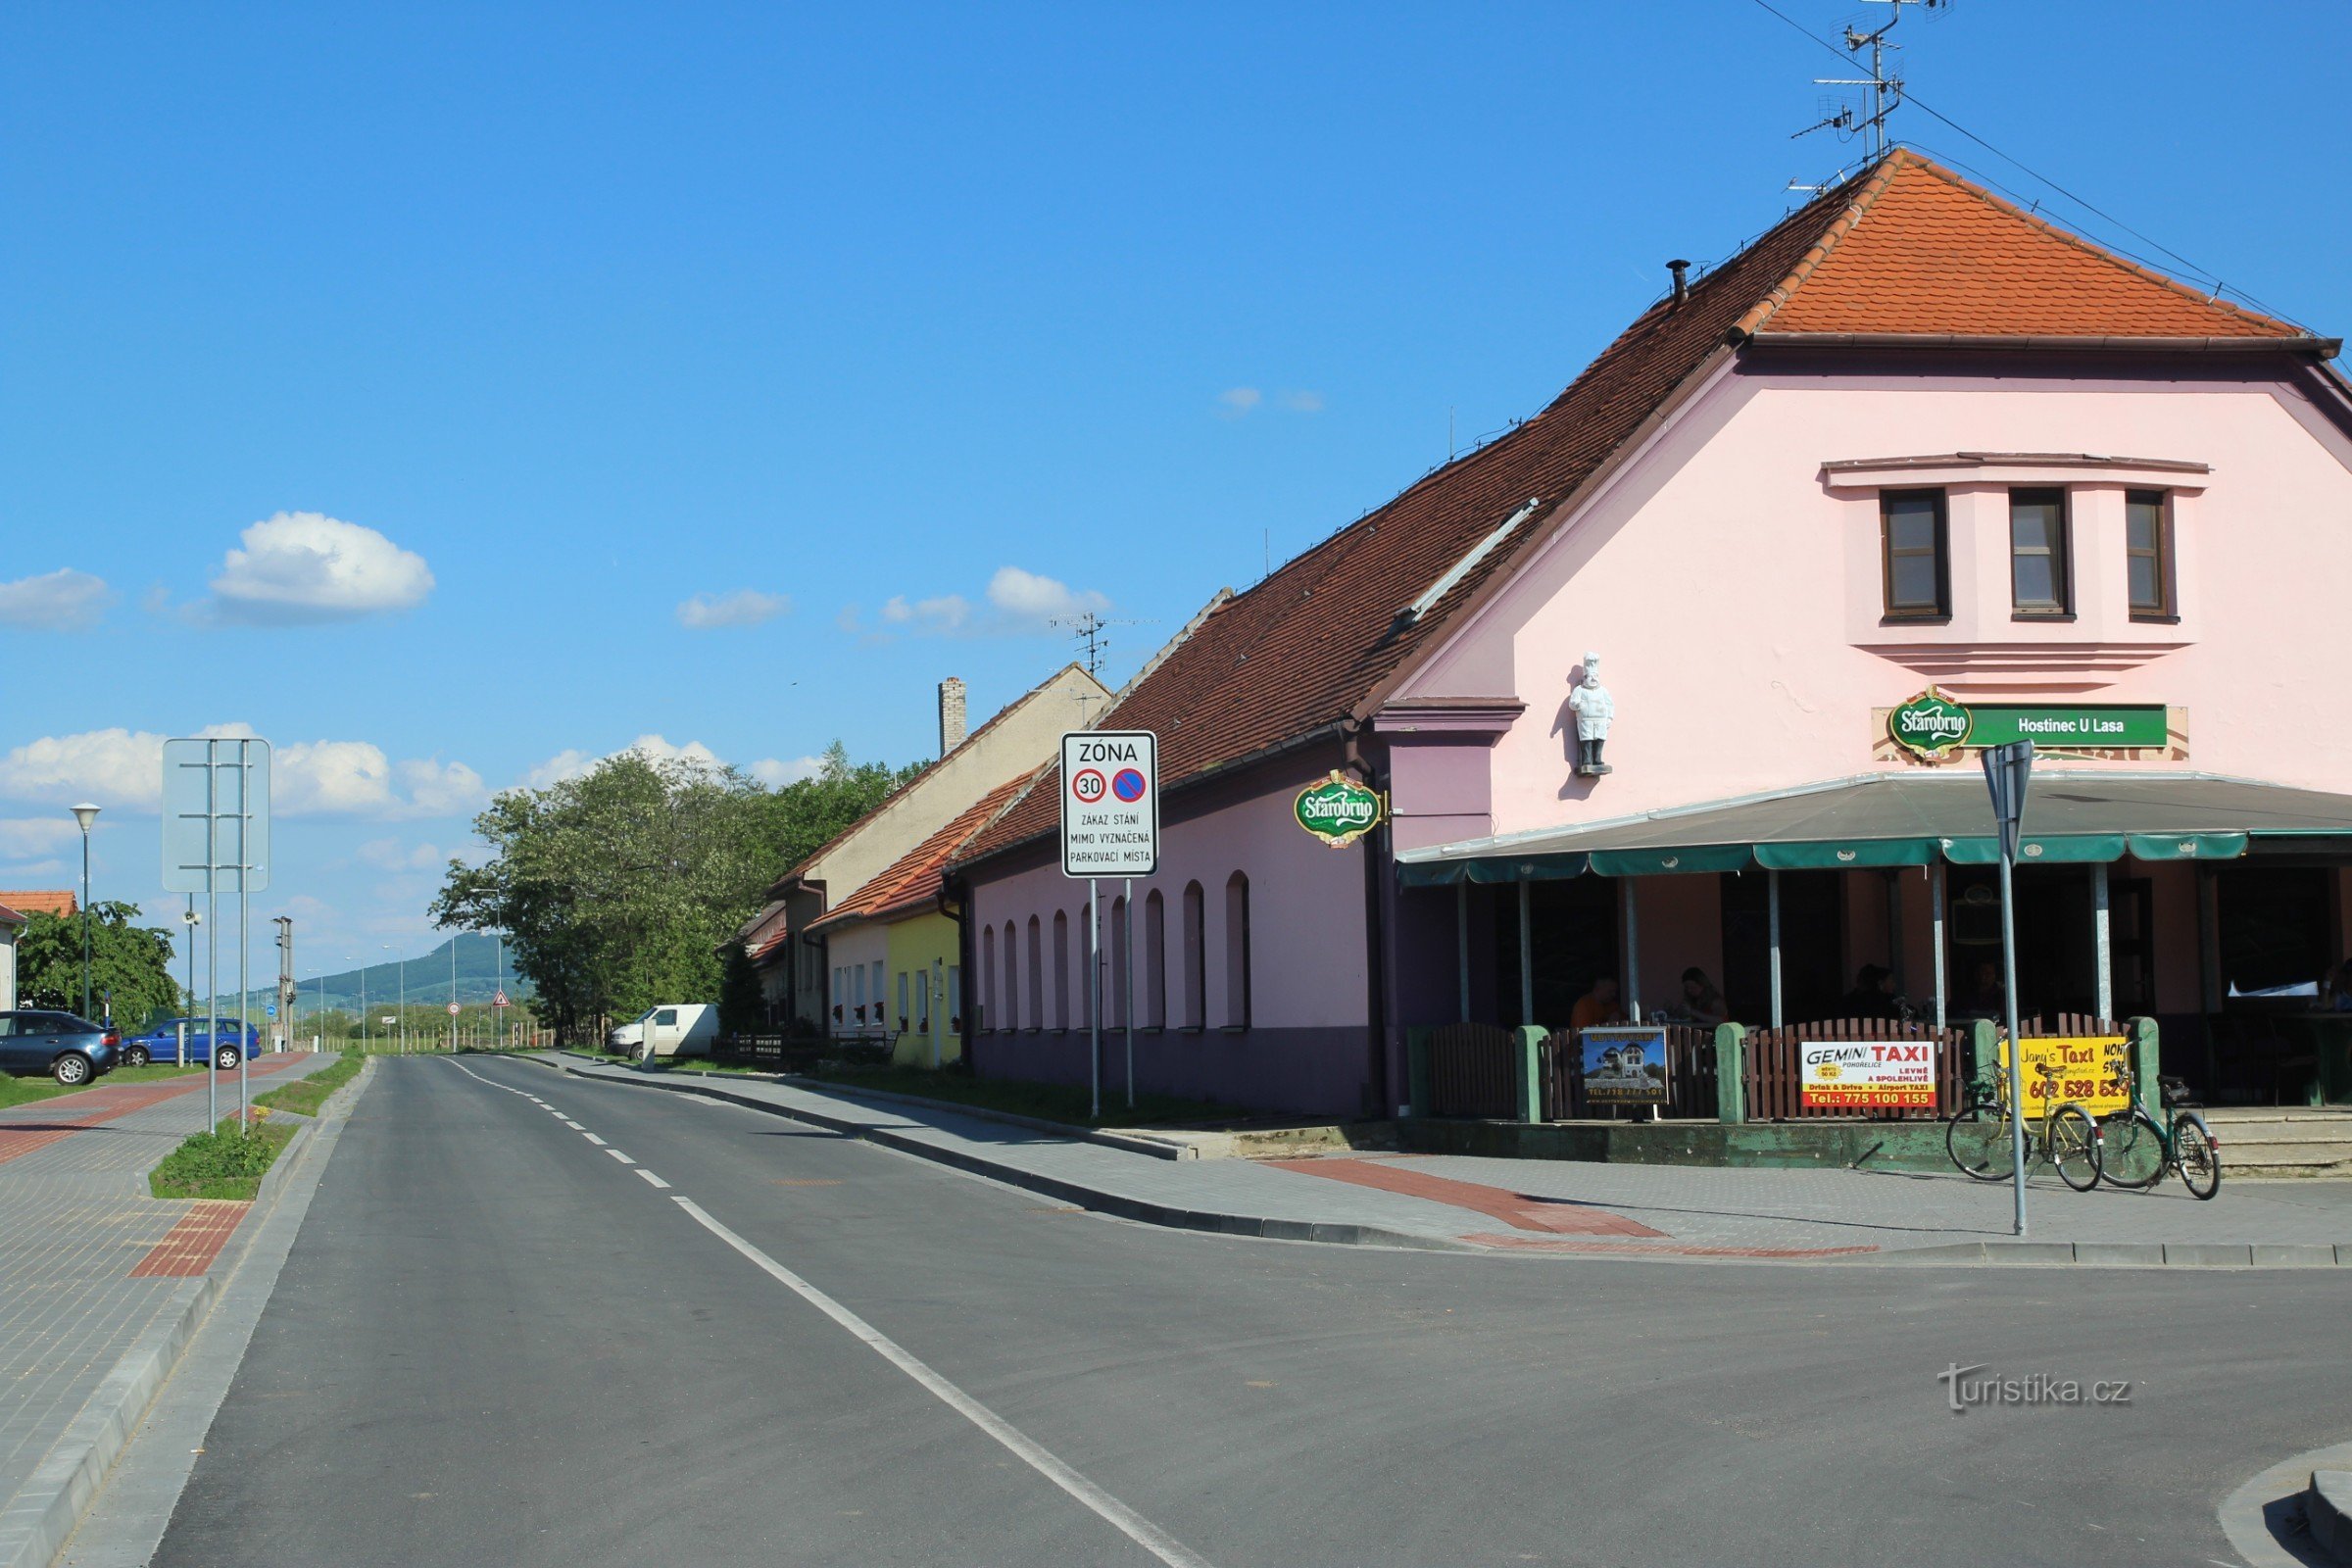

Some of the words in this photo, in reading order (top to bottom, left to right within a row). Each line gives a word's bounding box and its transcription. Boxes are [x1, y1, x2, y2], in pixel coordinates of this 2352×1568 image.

[1901, 706, 1966, 741] Starobrno
[2018, 717, 2076, 732] Hostinec
[2080, 717, 2089, 732] U
[2092, 717, 2124, 732] Lasa
[1079, 739, 1138, 762] ZÓNA
[1079, 778, 1101, 795] 30
[1304, 791, 1372, 827] Starobrno
[1081, 811, 1108, 825] ZÁKAZ
[1113, 811, 1139, 825] STÁNÍ
[1070, 833, 1095, 844] MIMO
[1100, 830, 1150, 844] VYZNAČENÁ
[1070, 849, 1119, 862] PARKOVACÍ
[1123, 849, 1151, 862] MÍSTA
[1806, 1047, 1868, 1064] GEMINI
[1871, 1046, 1929, 1061] TAXI
[2021, 1048, 2056, 1064] Jany's
[2056, 1045, 2094, 1063] Taxi
[2064, 1079, 2094, 1098] 528
[1809, 1093, 1840, 1103] Tel.:
[1844, 1093, 1870, 1103] 775
[1874, 1093, 1899, 1103] 100
[1903, 1093, 1929, 1103] 155
